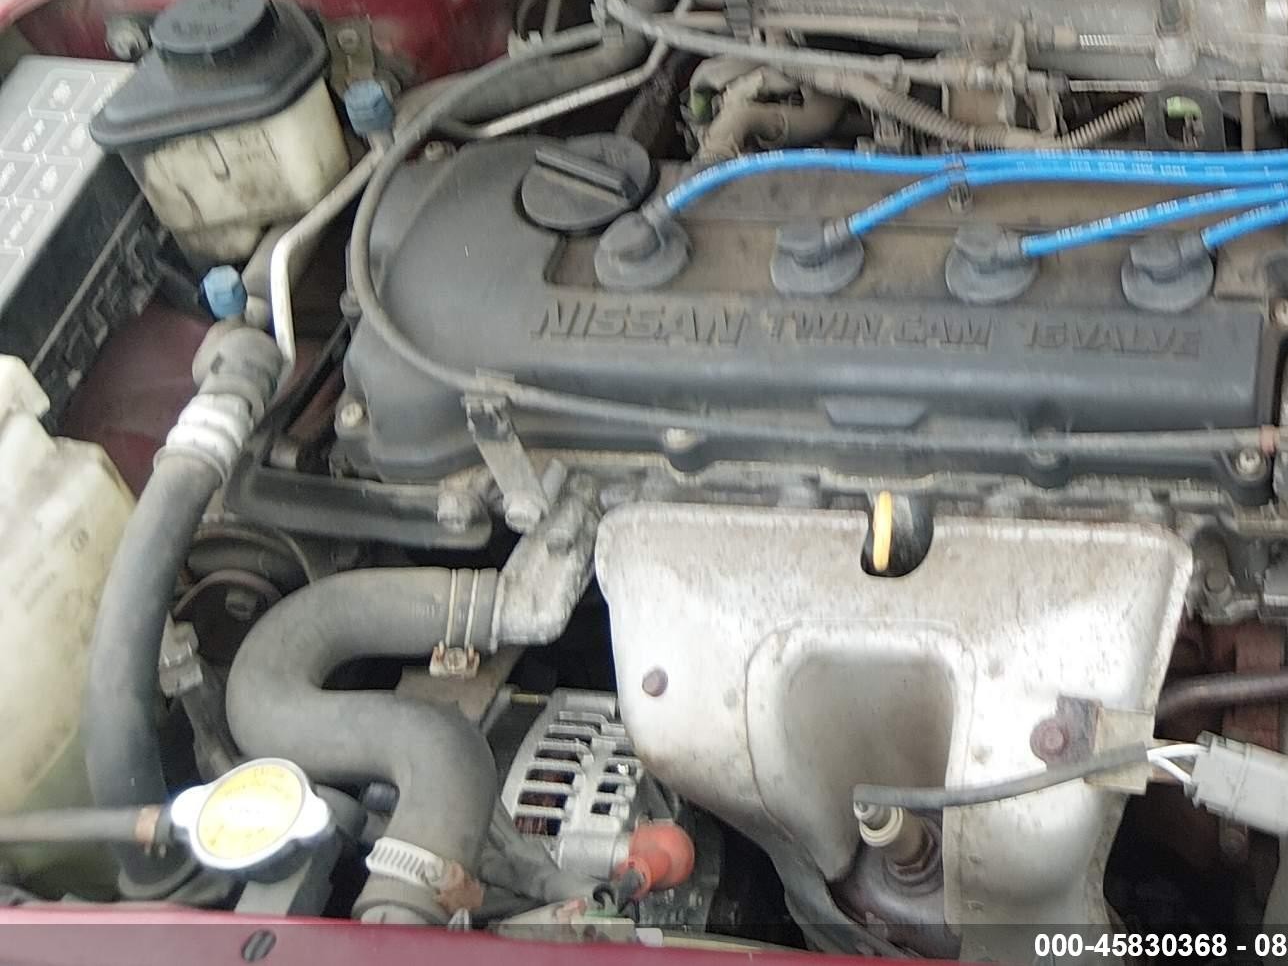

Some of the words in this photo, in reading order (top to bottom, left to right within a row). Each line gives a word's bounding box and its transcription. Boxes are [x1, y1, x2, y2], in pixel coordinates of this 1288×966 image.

[532, 298, 747, 346] NISSAN
[769, 306, 882, 347] TWIN
[894, 313, 994, 353] CAM
